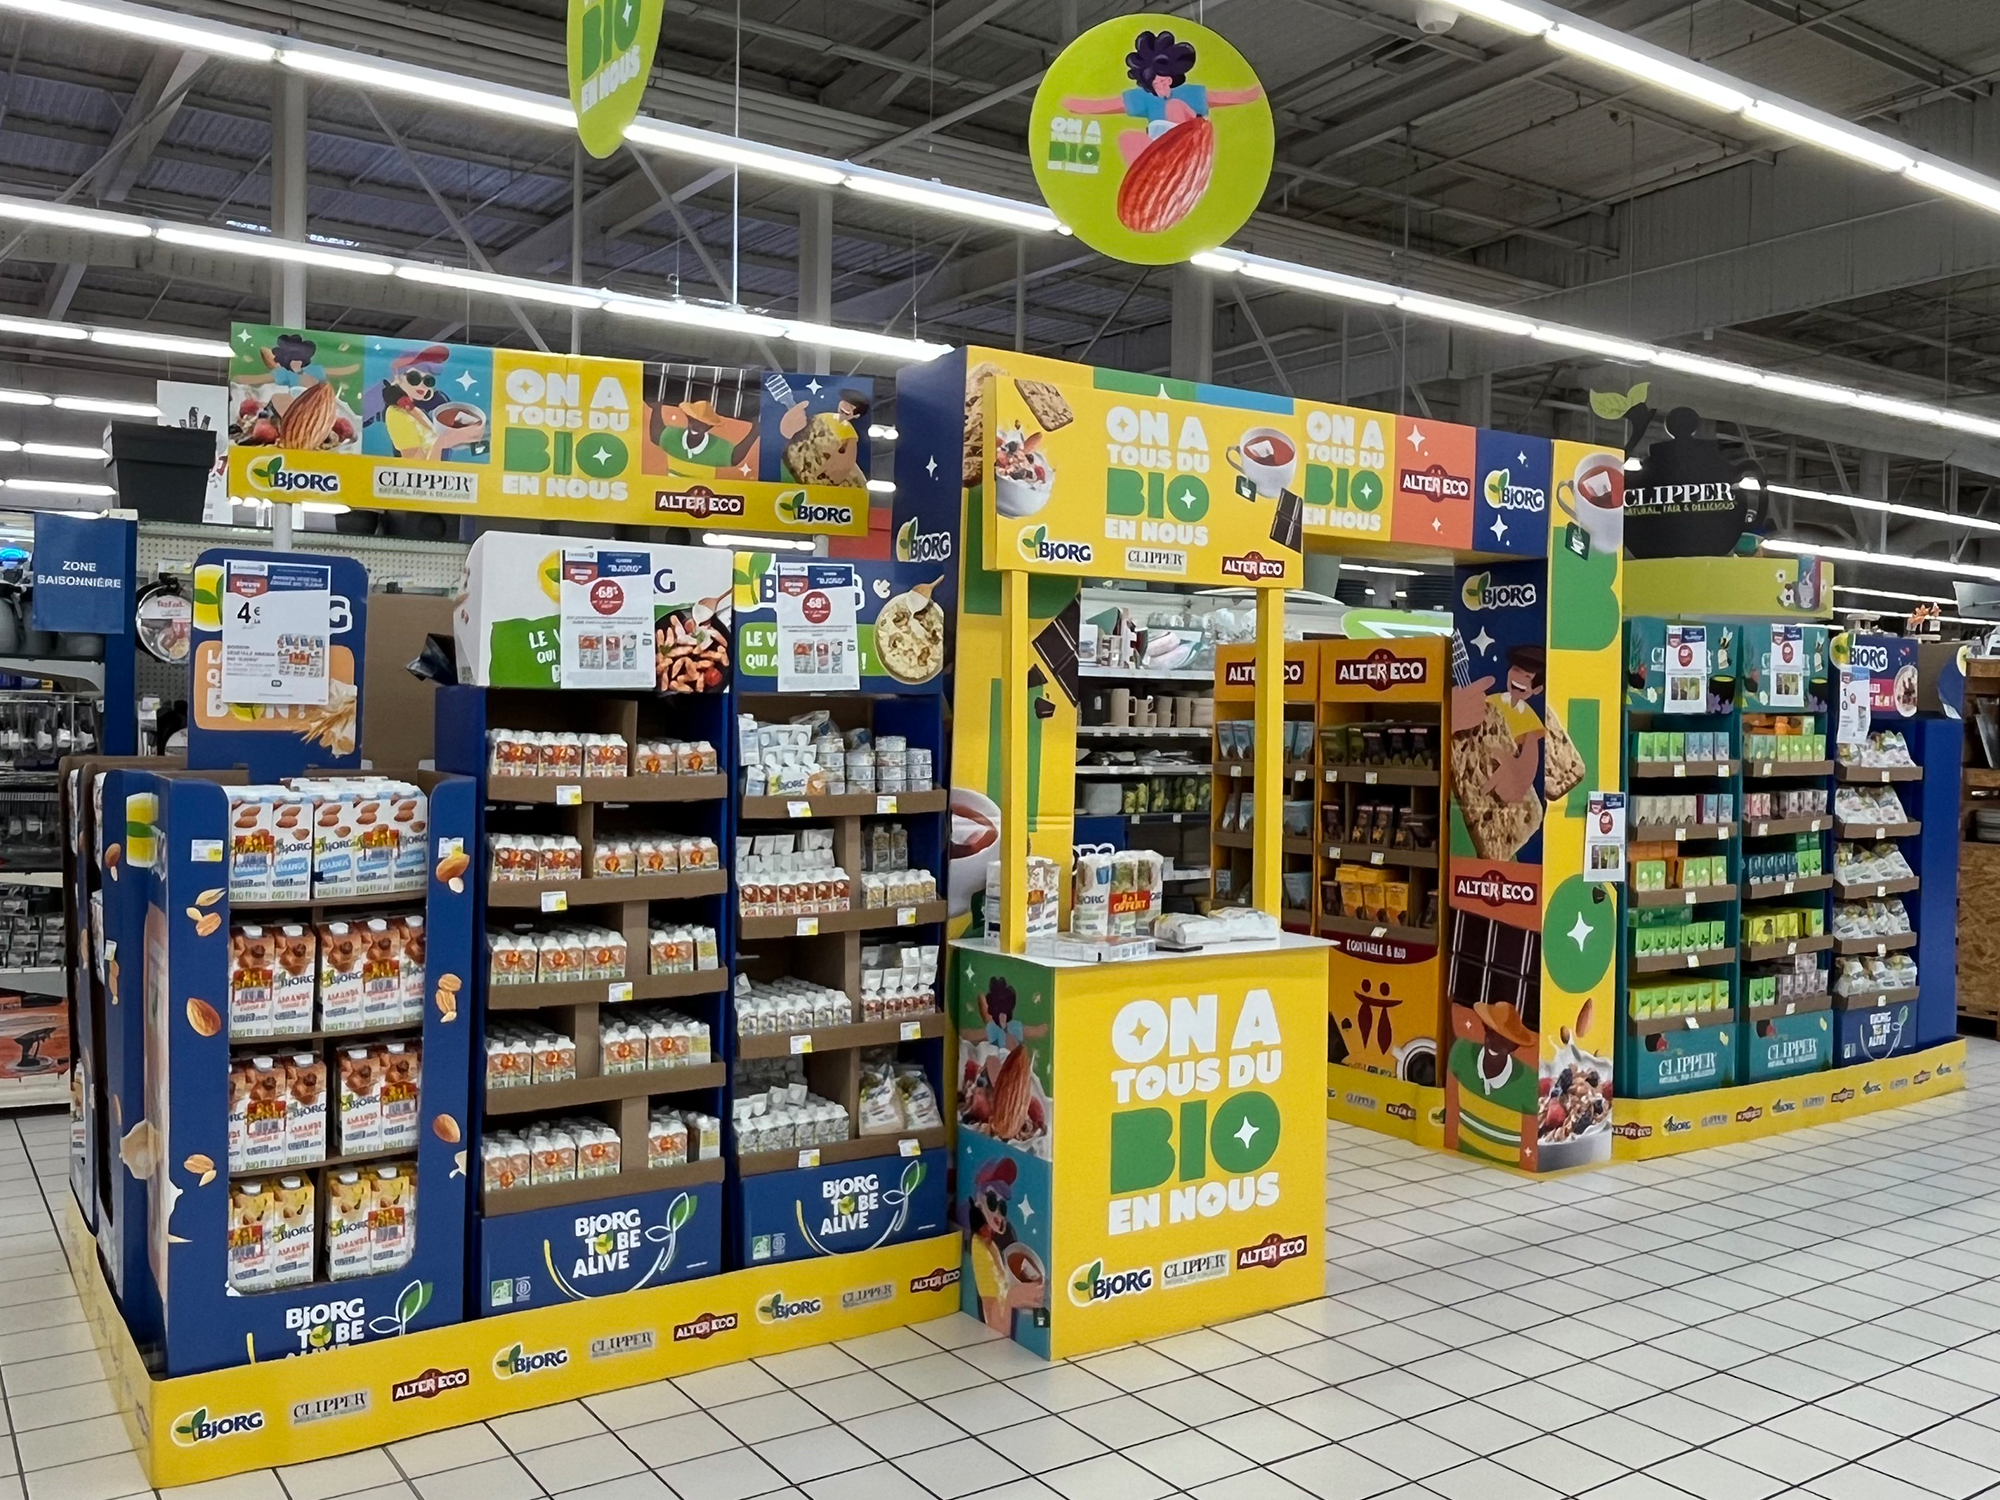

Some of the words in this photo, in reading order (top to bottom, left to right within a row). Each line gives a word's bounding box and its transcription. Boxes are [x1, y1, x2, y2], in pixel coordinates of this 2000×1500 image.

[1051, 117, 1082, 134] ON
[1085, 120, 1100, 135] A
[1049, 142, 1100, 165] BIO
[505, 368, 580, 409] ON
[591, 377, 628, 411] A
[505, 404, 582, 428] TOUS
[589, 410, 630, 432] DU
[1105, 404, 1169, 447] ON
[1178, 415, 1210, 452] A
[1306, 410, 1354, 446] ON
[1361, 419, 1385, 451] A
[504, 426, 629, 479] BIO
[1106, 443, 1172, 469] TOUS
[1177, 452, 1210, 474] DU
[1306, 443, 1355, 465] TOUS
[1360, 452, 1385, 469] DU
[378, 471, 471, 492] CLIPPER
[503, 475, 540, 496] EN
[546, 477, 628, 501] NOUS
[1304, 463, 1383, 511] BIO
[1402, 473, 1440, 492] ALTER
[1443, 478, 1468, 497] ECO
[659, 493, 704, 511] ALTER
[708, 497, 742, 513] ECO
[1106, 466, 1210, 523] BIO
[1623, 482, 1735, 507] CLIPPER
[1303, 508, 1328, 527] EN
[1330, 509, 1381, 531] NOUS
[1105, 518, 1137, 541] EN
[1141, 521, 1208, 546] NOUS
[63, 561, 96, 572] ZONE
[1128, 550, 1185, 567] CLIPPER
[1224, 559, 1258, 574] ALTER
[1259, 561, 1283, 576] ECO
[237, 602, 251, 624] 4
[529, 630, 547, 649] LE
[746, 631, 763, 647] LE
[537, 650, 556, 664] QUI
[746, 653, 767, 667] QUI
[1283, 663, 1301, 681] CO
[1339, 664, 1388, 681] ALTER
[1390, 662, 1423, 680] ECO
[1457, 881, 1499, 899] ALTER
[1502, 883, 1533, 901] ECO
[1112, 994, 1218, 1063] ON
[1231, 989, 1281, 1049] A
[1767, 1038, 1818, 1060] CLIPPER
[1658, 1052, 1716, 1076] CLIPPER
[1111, 1058, 1220, 1104] TOUS
[1229, 1050, 1281, 1088] DU
[1110, 1091, 1281, 1195] BIO
[858, 1193, 879, 1210] BE
[1109, 1195, 1160, 1236] EN
[1169, 1172, 1280, 1224] NOUS
[617, 1229, 641, 1250] BE
[1240, 1245, 1278, 1266] ALTER
[1279, 1239, 1305, 1256] ECO
[1164, 1255, 1227, 1278] CLIPPER
[842, 1285, 892, 1304] CLIPPER
[335, 1320, 365, 1342] BE
[675, 1321, 710, 1339] ALTER
[711, 1315, 736, 1330] ECO
[591, 1331, 653, 1353] CLIPPER
[395, 1378, 436, 1399] ALTER
[438, 1373, 467, 1388] ECO
[294, 1392, 366, 1418] CLIPPER
